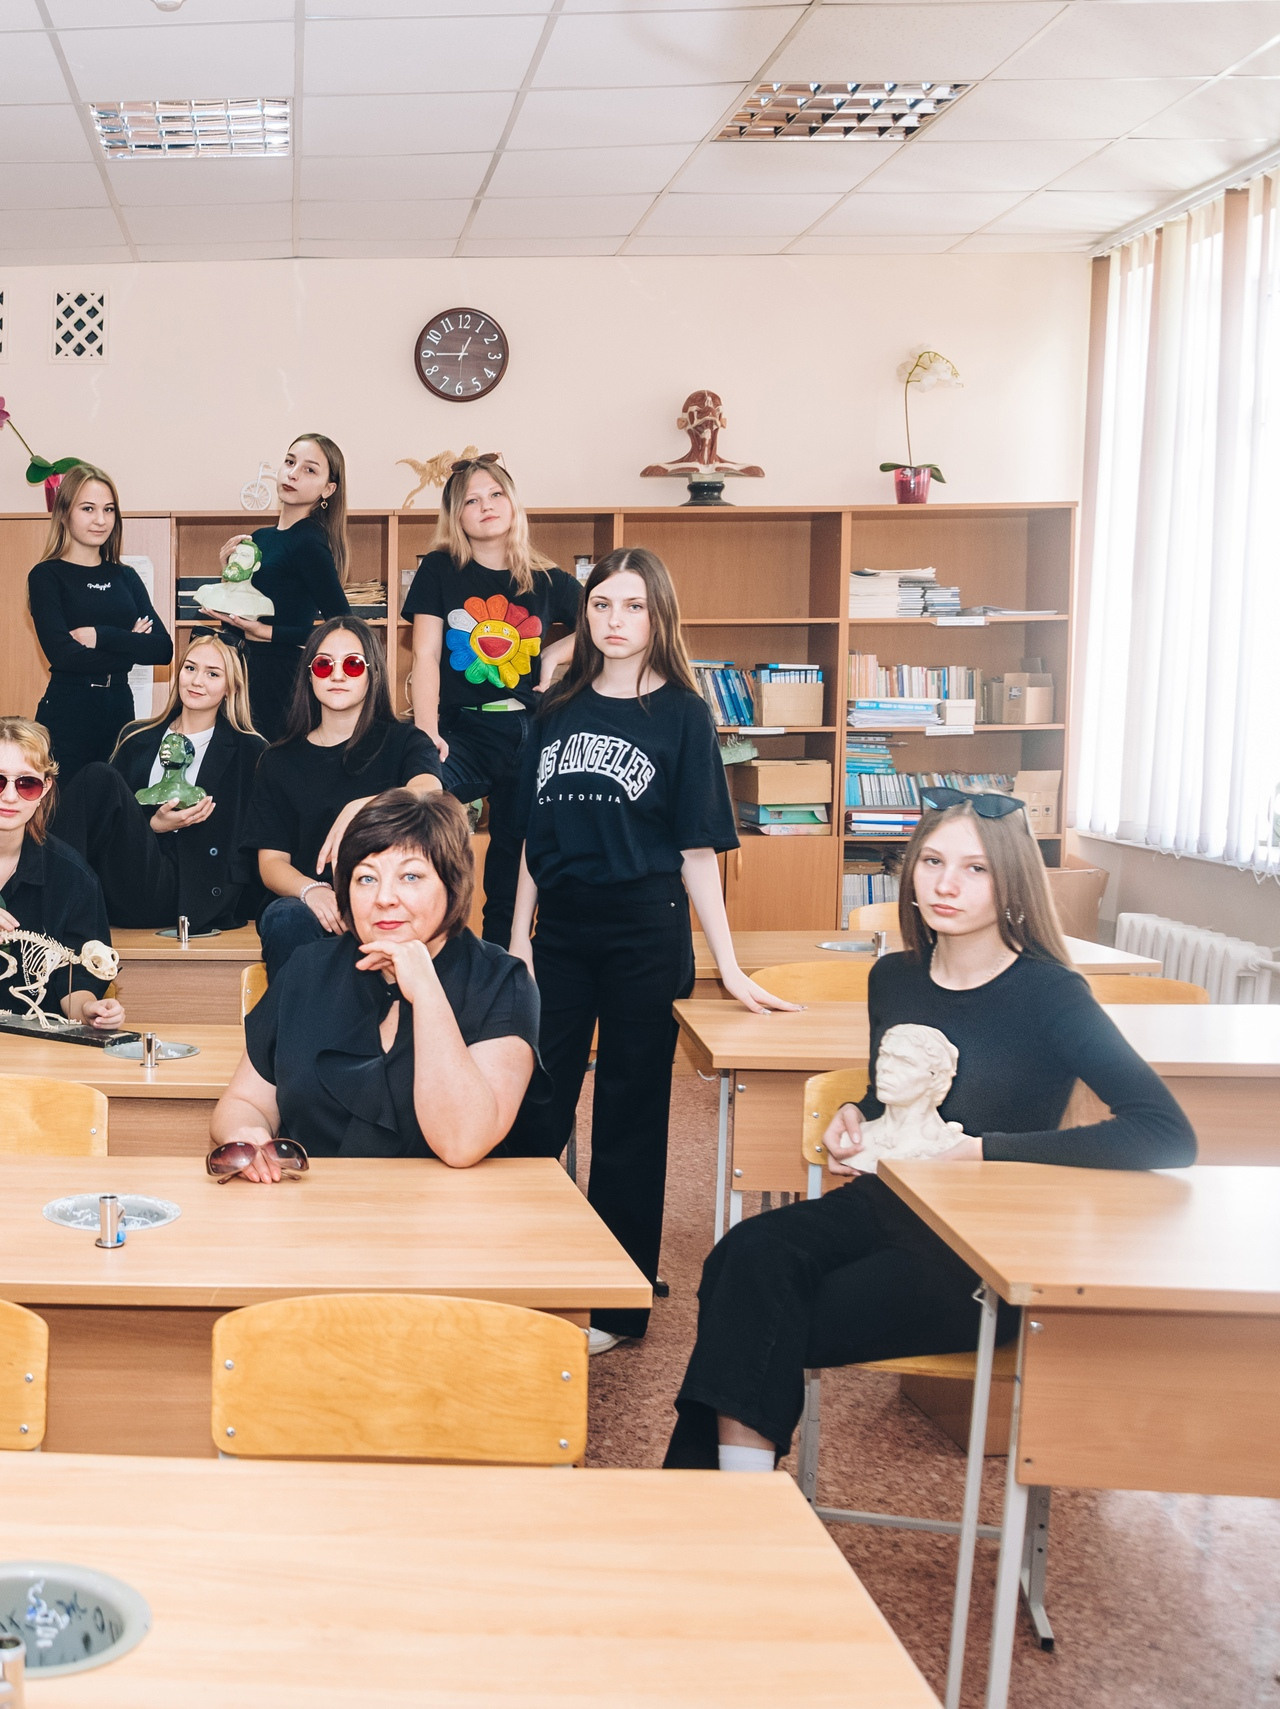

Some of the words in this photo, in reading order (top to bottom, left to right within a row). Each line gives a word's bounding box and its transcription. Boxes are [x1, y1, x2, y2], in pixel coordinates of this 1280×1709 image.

[440, 317, 454, 334] 11
[458, 314, 471, 329] 12
[475, 320, 485, 334] 1
[426, 329, 442, 346] 10
[483, 333, 498, 345] 2
[421, 349, 435, 358] 9
[487, 352, 502, 360] 3
[425, 365, 439, 376] 8
[483, 367, 496, 379] 4
[440, 375, 449, 390] 7
[455, 381, 463, 395] 6
[471, 376, 482, 392] 5
[558, 732, 656, 801] ANGELES
